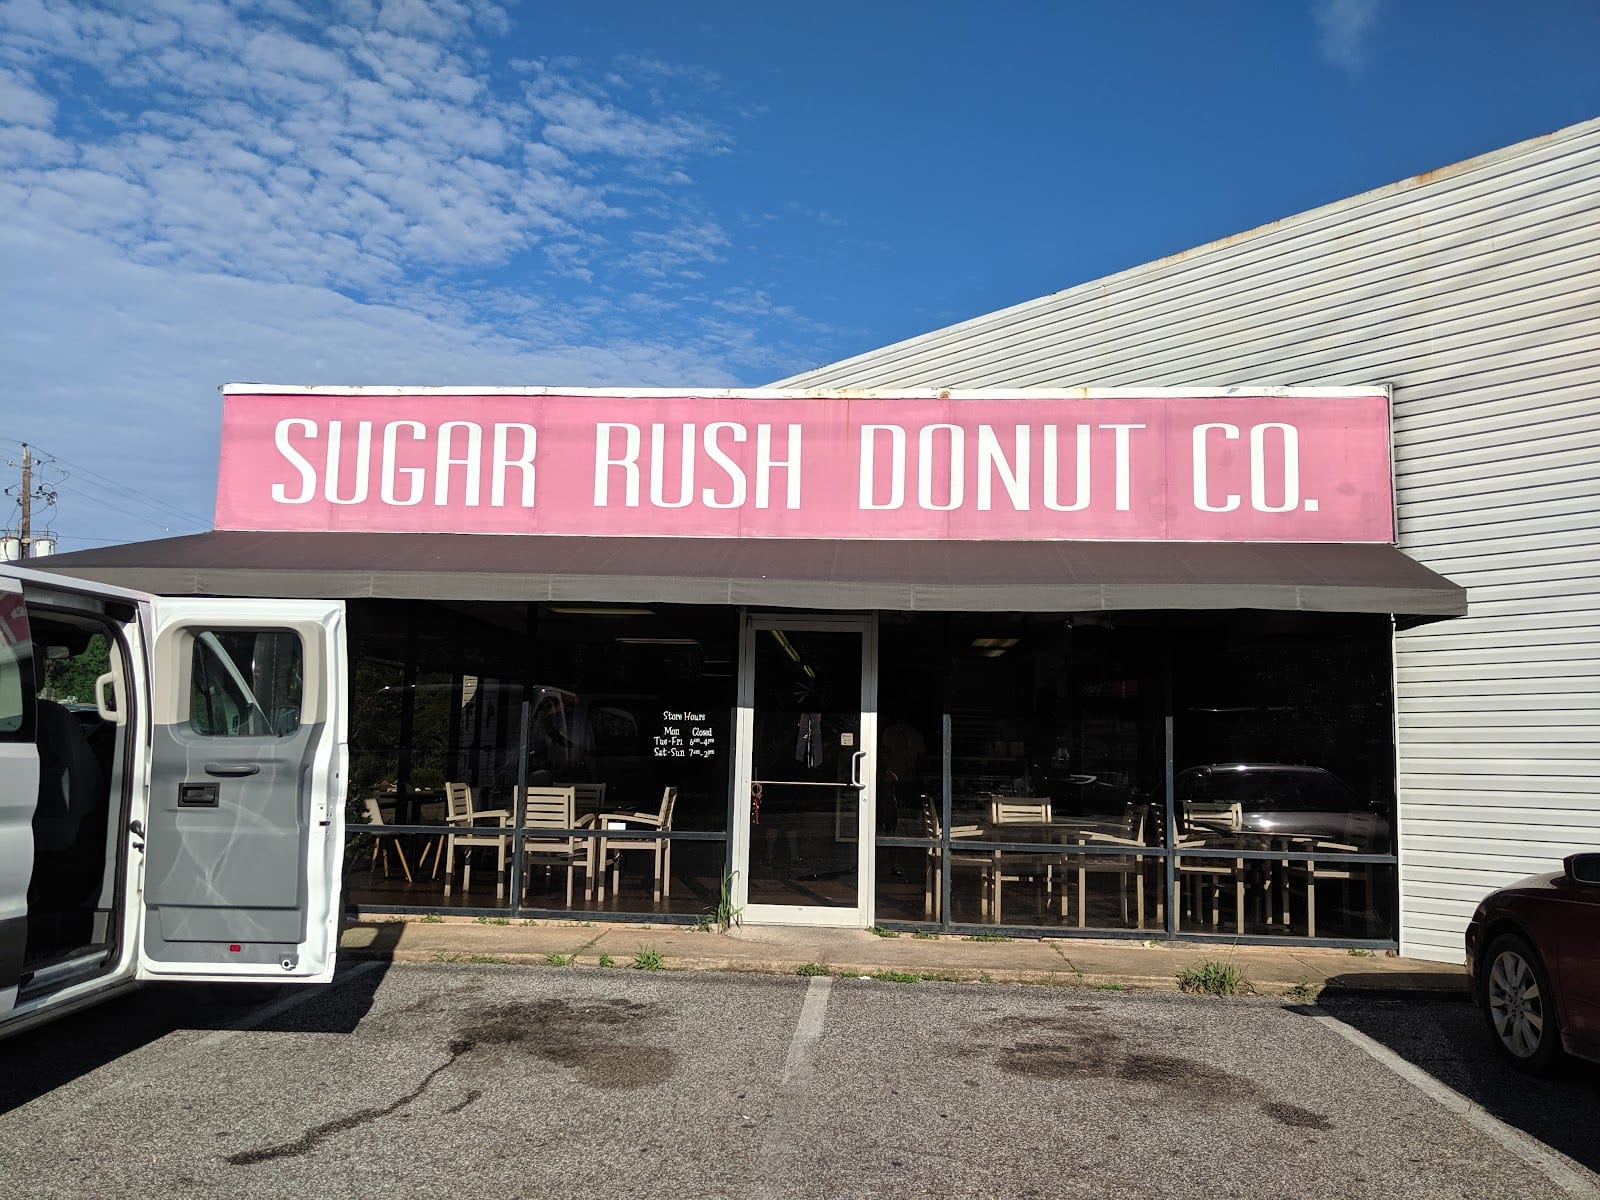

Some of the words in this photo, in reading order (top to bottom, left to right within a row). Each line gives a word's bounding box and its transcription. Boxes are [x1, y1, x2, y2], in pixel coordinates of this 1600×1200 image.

[271, 418, 537, 507] SUGAR
[593, 421, 803, 510] RUSH
[859, 423, 1146, 511] DONUT
[1192, 422, 1319, 513] CO.
[663, 711, 682, 720] Store
[684, 712, 705, 720] Hours
[664, 727, 680, 735] Mon
[692, 727, 712, 736] Closed
